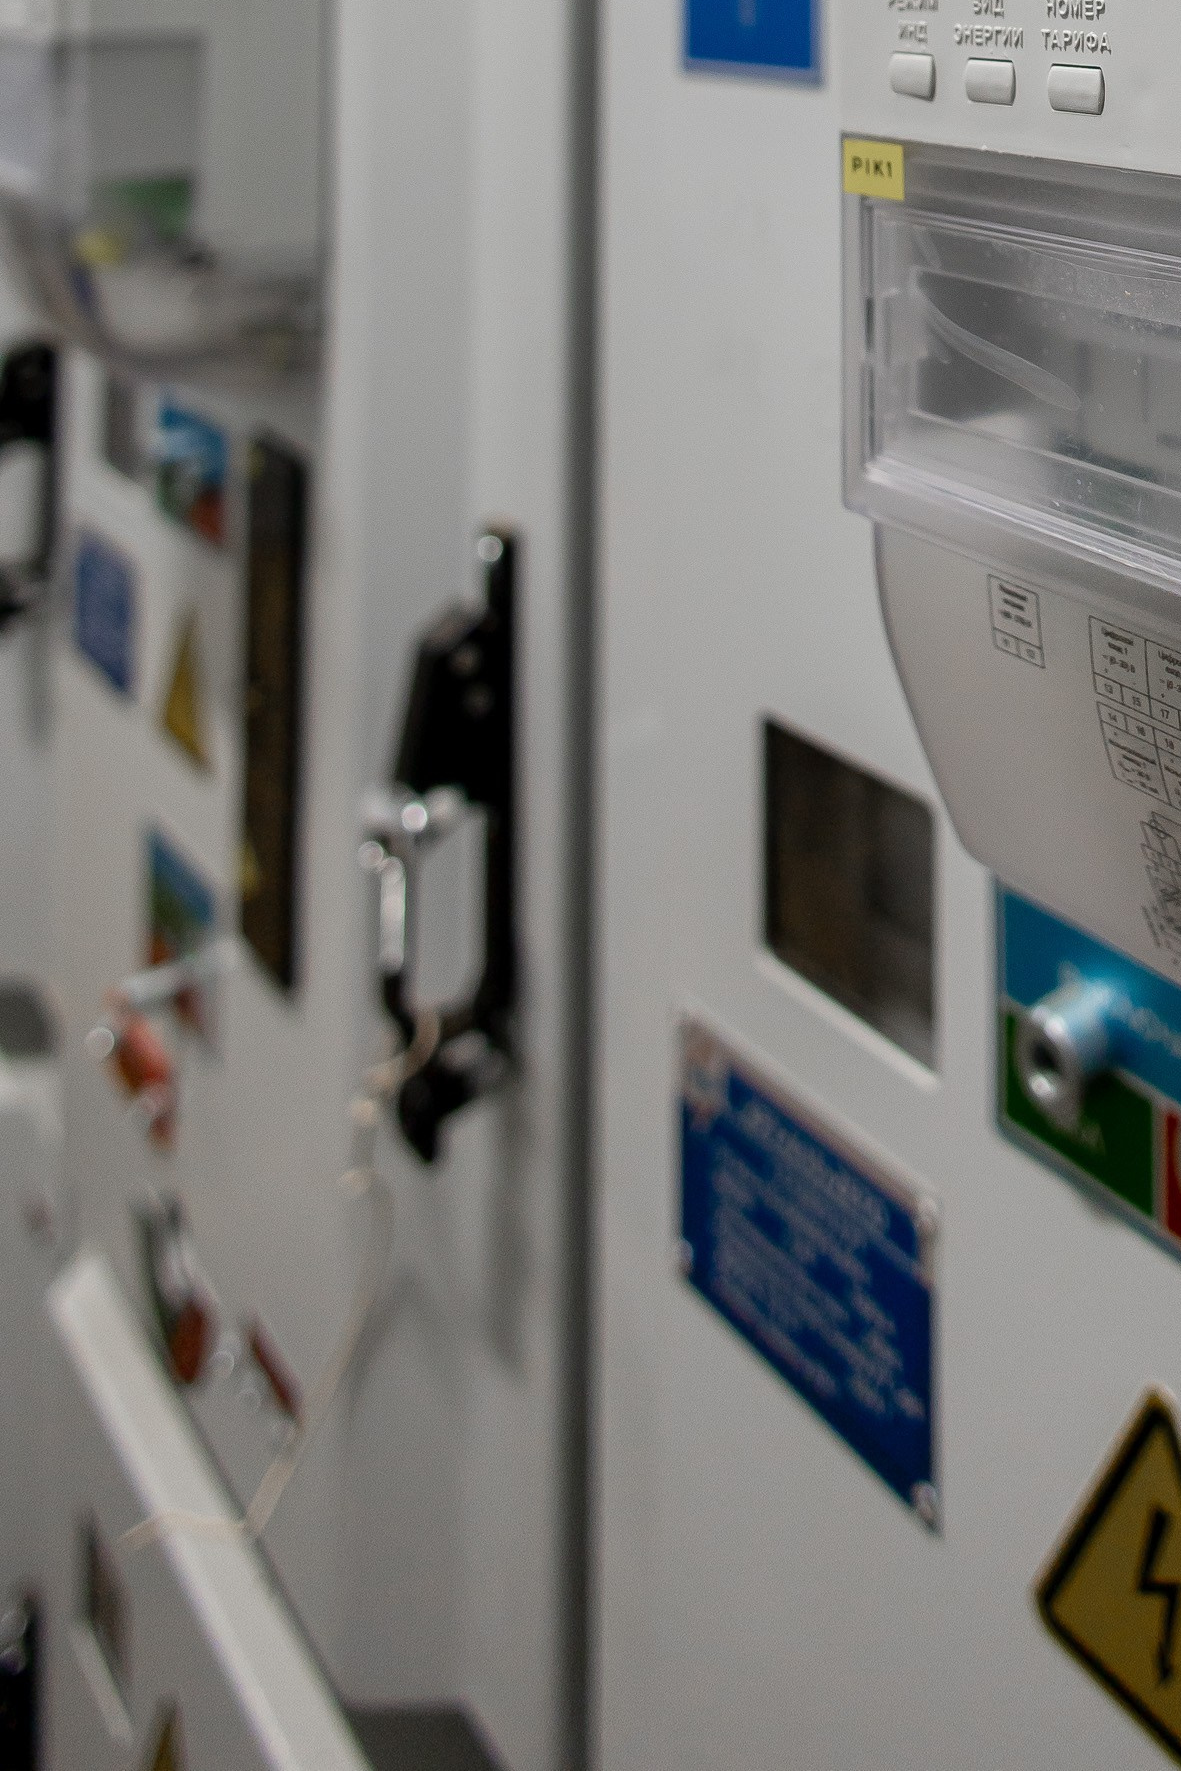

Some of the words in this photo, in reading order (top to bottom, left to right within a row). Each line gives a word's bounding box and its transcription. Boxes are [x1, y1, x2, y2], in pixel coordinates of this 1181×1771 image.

[897, 20, 928, 44] ИНД
[954, 23, 1024, 49] ЭНЕРГИИ
[1040, 27, 1112, 55] ТАРИФА
